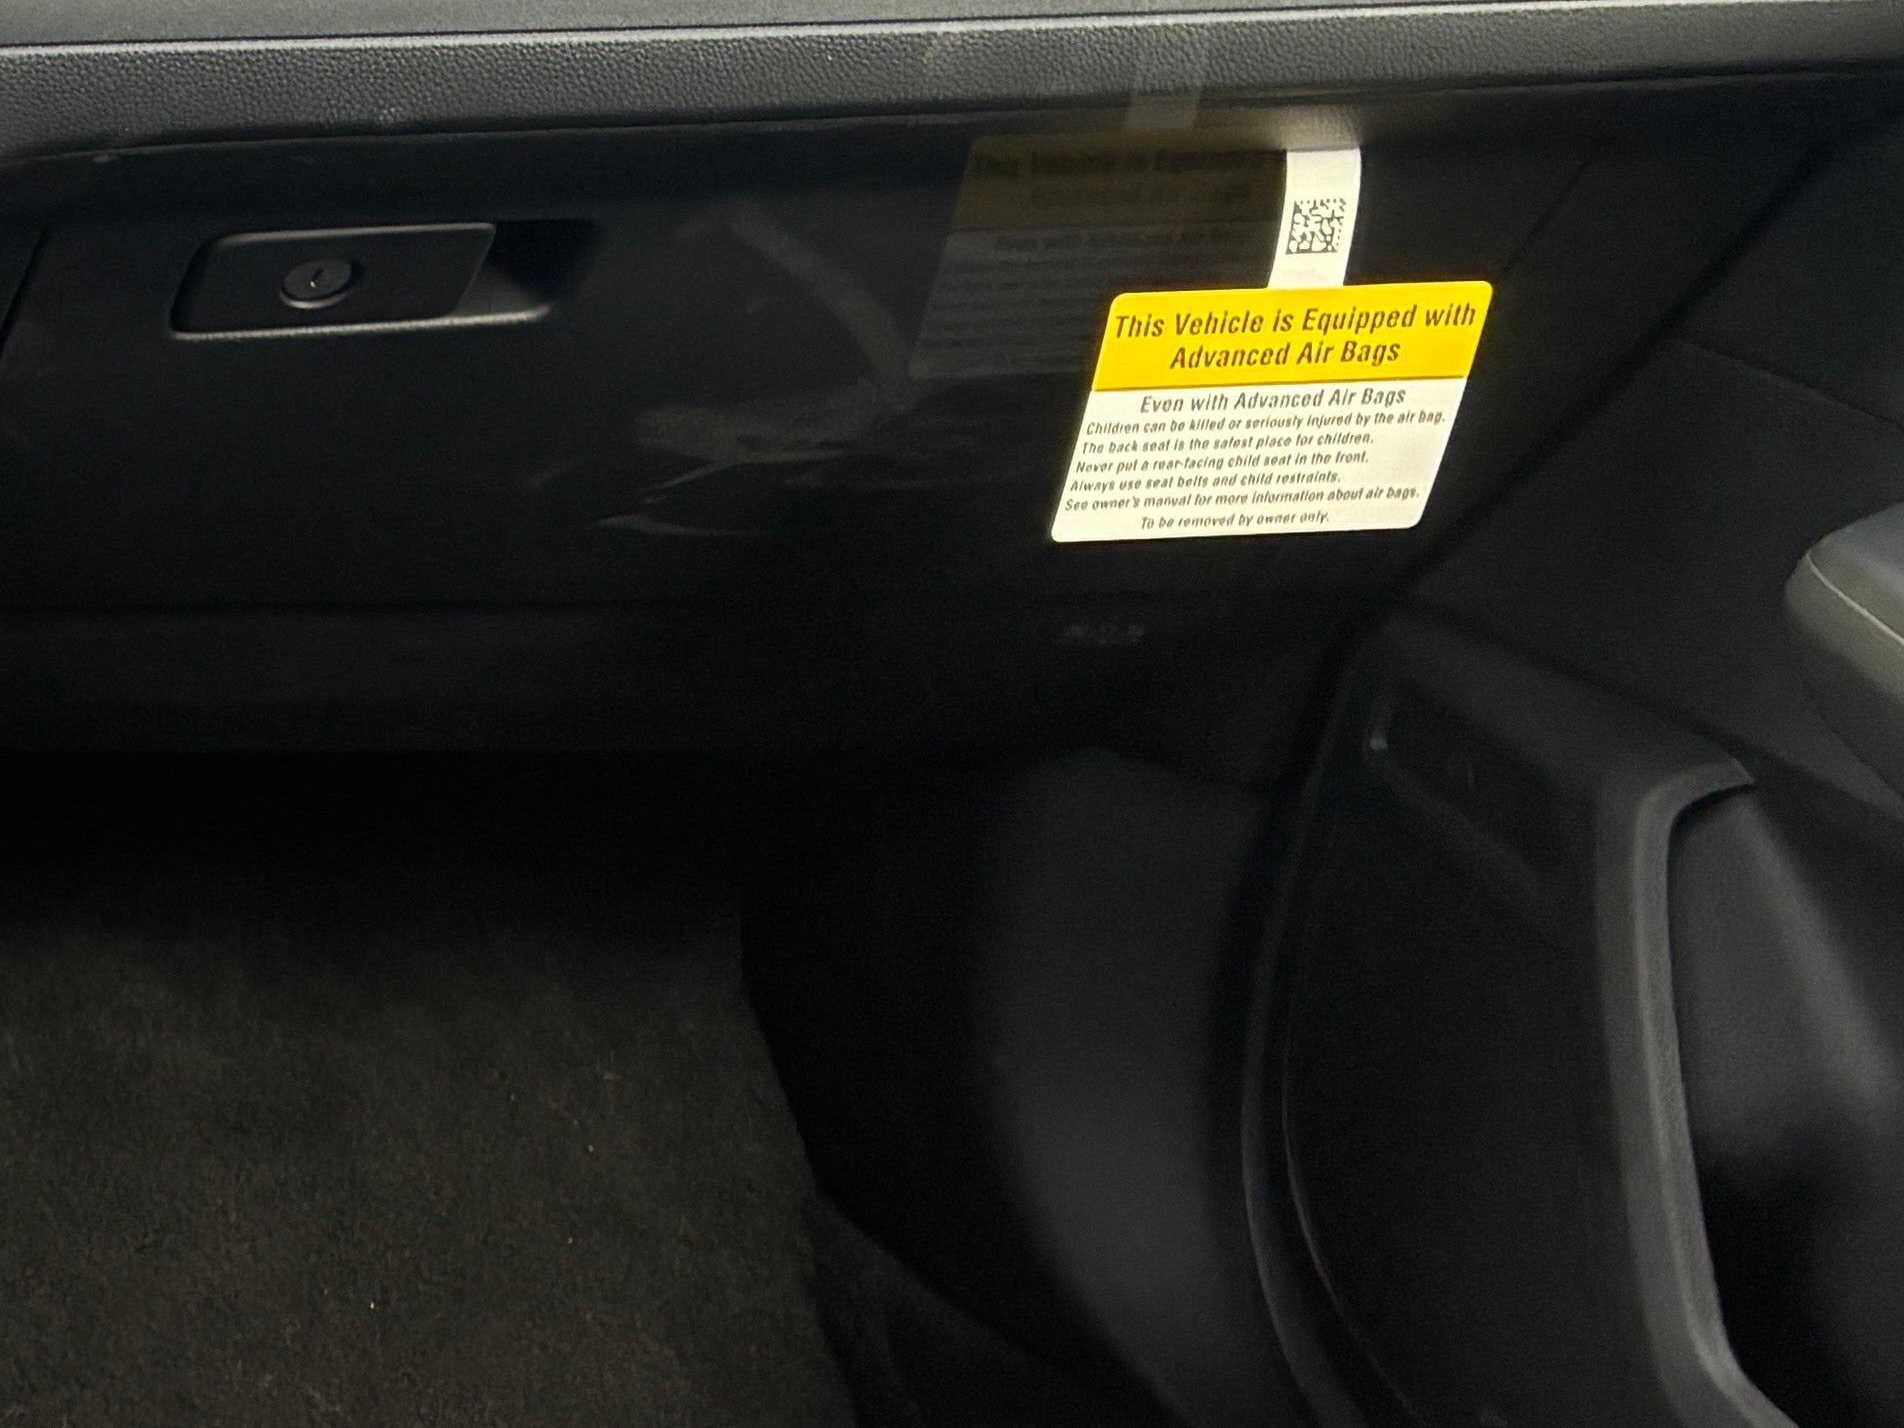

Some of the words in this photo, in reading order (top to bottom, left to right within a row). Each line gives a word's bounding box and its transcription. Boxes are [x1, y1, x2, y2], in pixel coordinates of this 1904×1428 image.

[1115, 313, 1165, 339] This
[1175, 310, 1264, 336] Vehicle
[1272, 308, 1294, 333] is
[1301, 304, 1418, 335] Equipped
[1424, 303, 1476, 327] with
[1169, 341, 1291, 370] Advanced
[1296, 340, 1335, 364] Air
[1340, 340, 1401, 367] Bags
[1140, 395, 1184, 414] Even
[1191, 393, 1228, 413] with
[1233, 389, 1324, 410] Advanced
[1329, 388, 1357, 407] Air
[1361, 387, 1407, 408] Bags
[1086, 421, 1140, 436] Children
[1143, 422, 1166, 434] can
[1170, 420, 1186, 433] be
[1189, 417, 1226, 431] killed
[1228, 419, 1242, 430] or
[1244, 415, 1304, 430] seriously
[1306, 412, 1352, 429] injured
[1355, 411, 1371, 427] by
[1374, 412, 1394, 425] the
[1397, 409, 1415, 422] air
[1418, 409, 1446, 426] bag.
[1082, 442, 1104, 454] The
[1108, 440, 1138, 454] back
[1142, 439, 1171, 452] seat
[1173, 438, 1185, 451] is
[1189, 438, 1210, 450] the
[1213, 435, 1253, 450] safest
[1255, 434, 1292, 451] place
[1295, 433, 1314, 447] for
[1316, 432, 1374, 446] children.
[1076, 460, 1113, 474] Never
[1116, 459, 1138, 475] put
[1141, 460, 1150, 472] a
[1152, 456, 1225, 471] rear-facing
[1227, 454, 1260, 468] child
[1263, 453, 1292, 467] seat
[1294, 452, 1307, 465] in
[1311, 452, 1332, 465] the
[1335, 449, 1369, 464] front.
[1070, 479, 1116, 494] Always
[1118, 478, 1142, 491] use
[1145, 476, 1174, 490] seat
[1177, 474, 1209, 489] belts
[1212, 473, 1238, 487] and
[1240, 472, 1273, 487] child
[1275, 470, 1342, 485] restraints.
[1064, 498, 1089, 512] See
[1091, 495, 1141, 511] owner's
[1143, 493, 1192, 508] manual
[1194, 493, 1213, 506] for
[1214, 493, 1249, 506] more
[1251, 489, 1324, 505] information
[1327, 486, 1364, 502] about
[1365, 486, 1385, 499] air
[1385, 485, 1420, 501] bags.
[1141, 516, 1155, 531] To
[1158, 515, 1175, 529] be
[1177, 513, 1236, 528] removed
[1238, 513, 1254, 528] by
[1256, 512, 1297, 526] owner
[1299, 510, 1330, 525] only.
